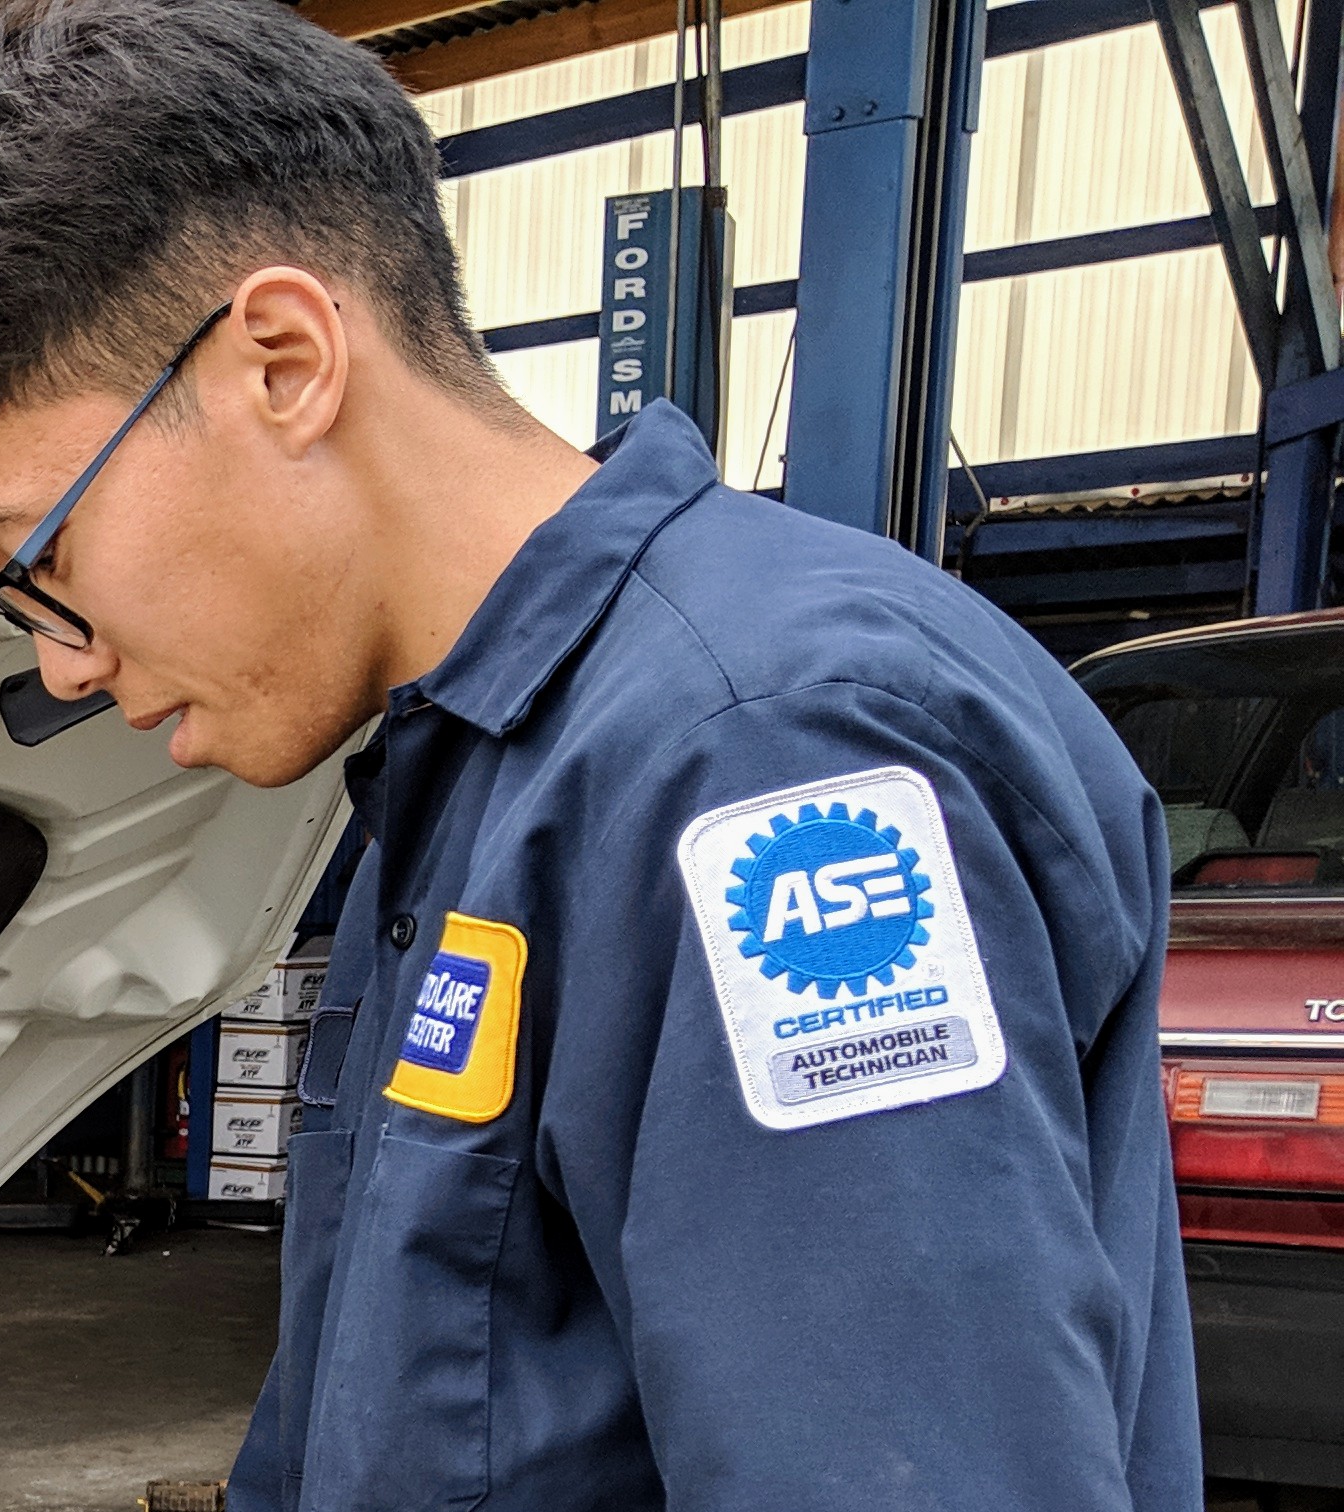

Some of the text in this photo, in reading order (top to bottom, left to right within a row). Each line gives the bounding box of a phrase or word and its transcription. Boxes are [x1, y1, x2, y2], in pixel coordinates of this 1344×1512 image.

[762, 851, 912, 943] ASE
[773, 984, 949, 1040] CERTIFIED
[789, 1022, 951, 1073] AUTOMOBILE
[802, 1043, 948, 1090] TECHNICIAN
